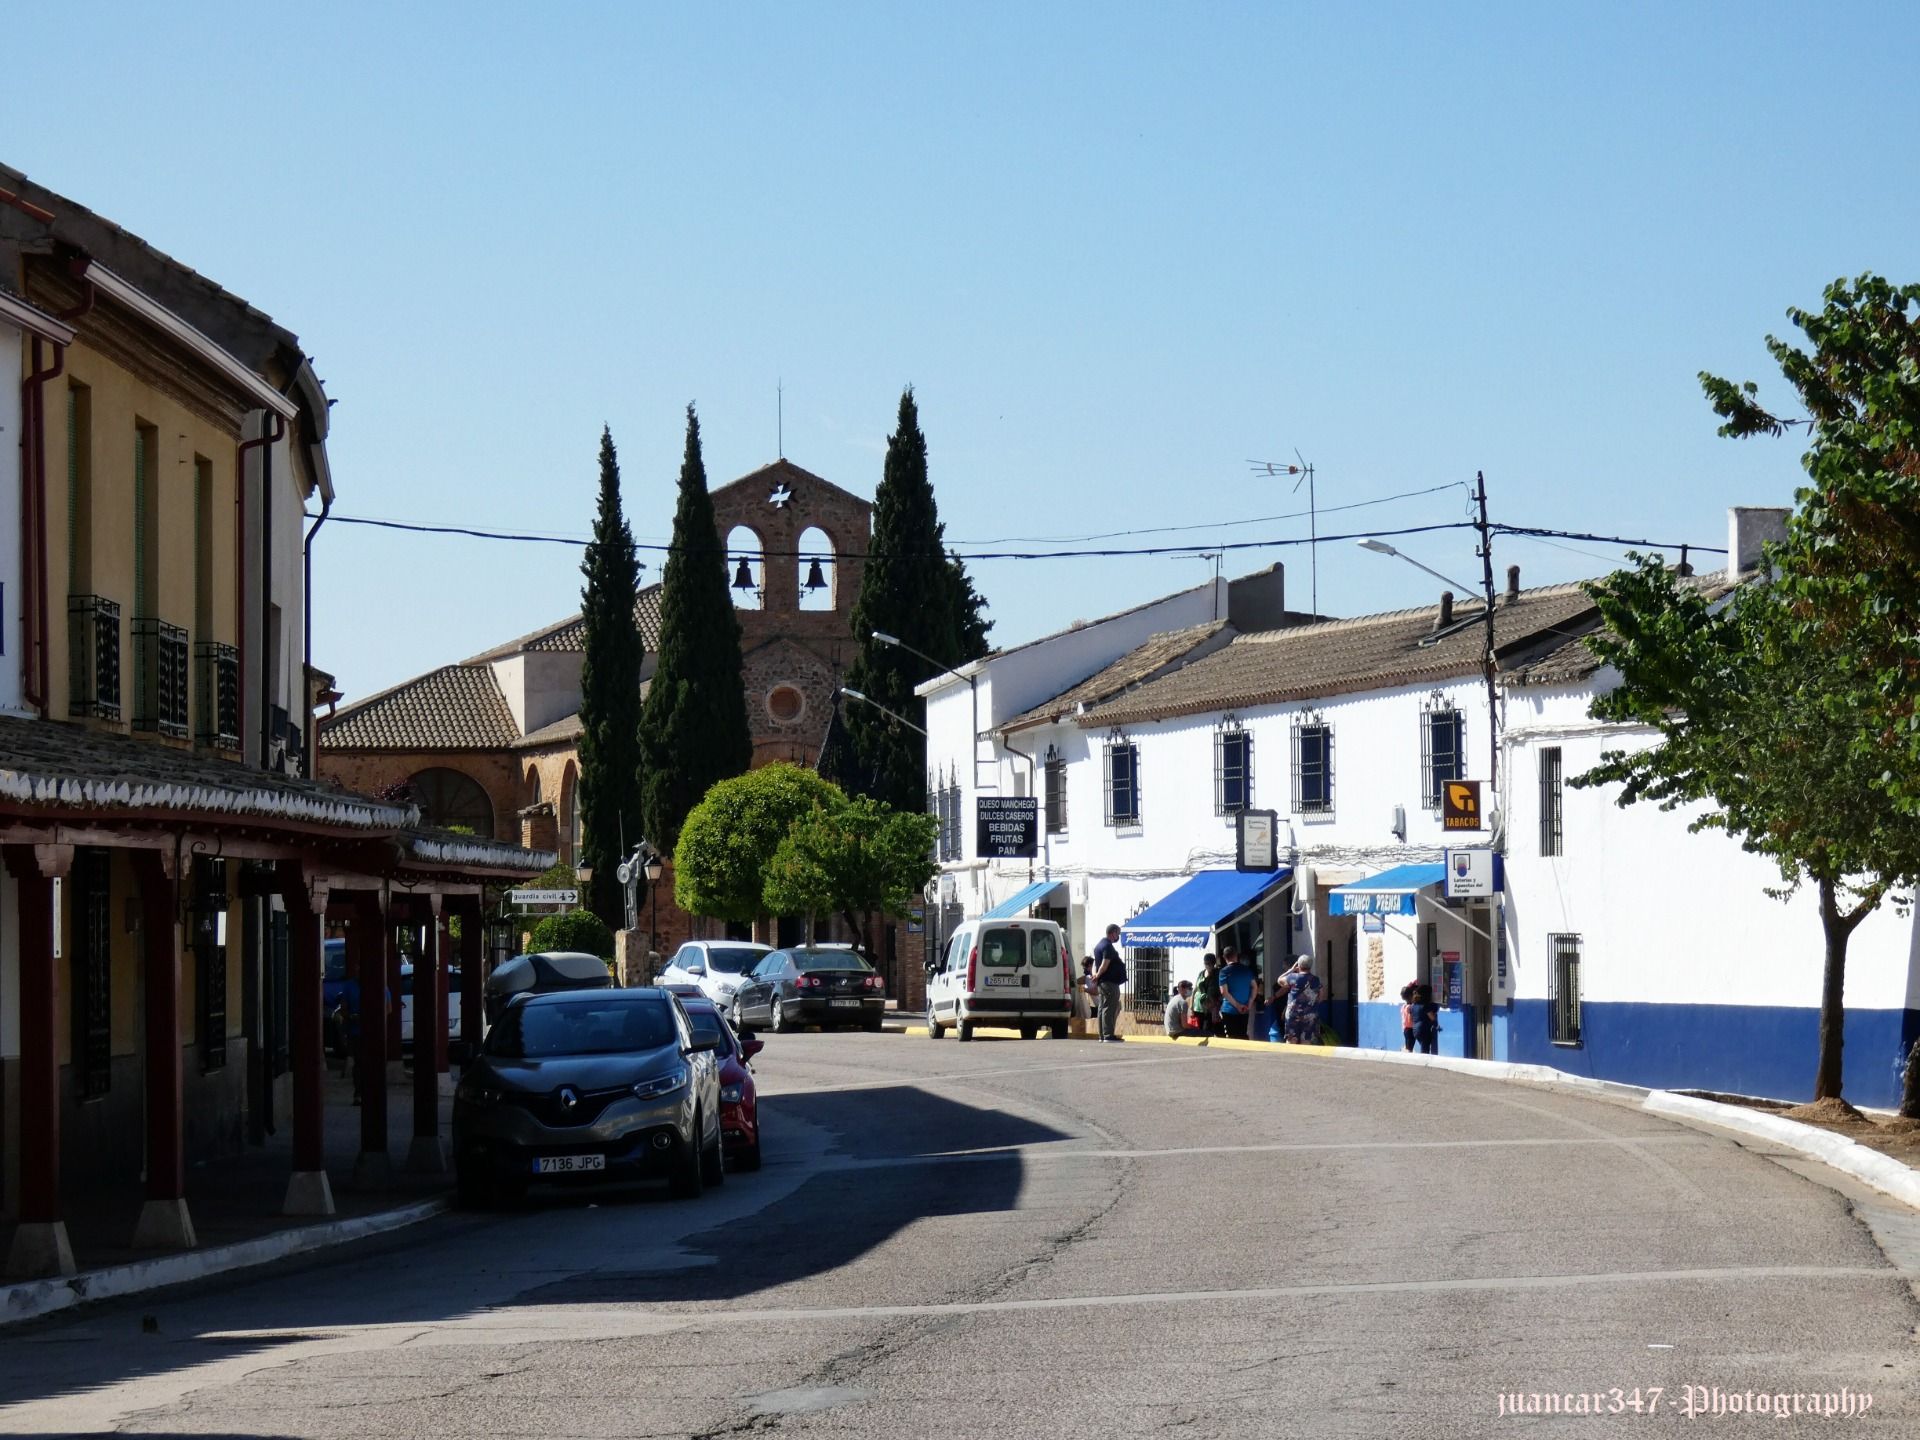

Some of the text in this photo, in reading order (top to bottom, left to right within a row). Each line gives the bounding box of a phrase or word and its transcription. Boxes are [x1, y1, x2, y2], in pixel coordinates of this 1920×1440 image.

[979, 800, 1036, 809] QUESO MANCHEGO
[980, 811, 1034, 820] DULCES CASEROS
[1445, 817, 1479, 827] TABACOS
[989, 823, 1025, 832] BEBIDAS
[990, 835, 1024, 843] FRUTAS
[998, 847, 1016, 855] PAN
[1343, 894, 1401, 911] ESTANCO PRENSA
[542, 1156, 601, 1171] 7136 JPG
